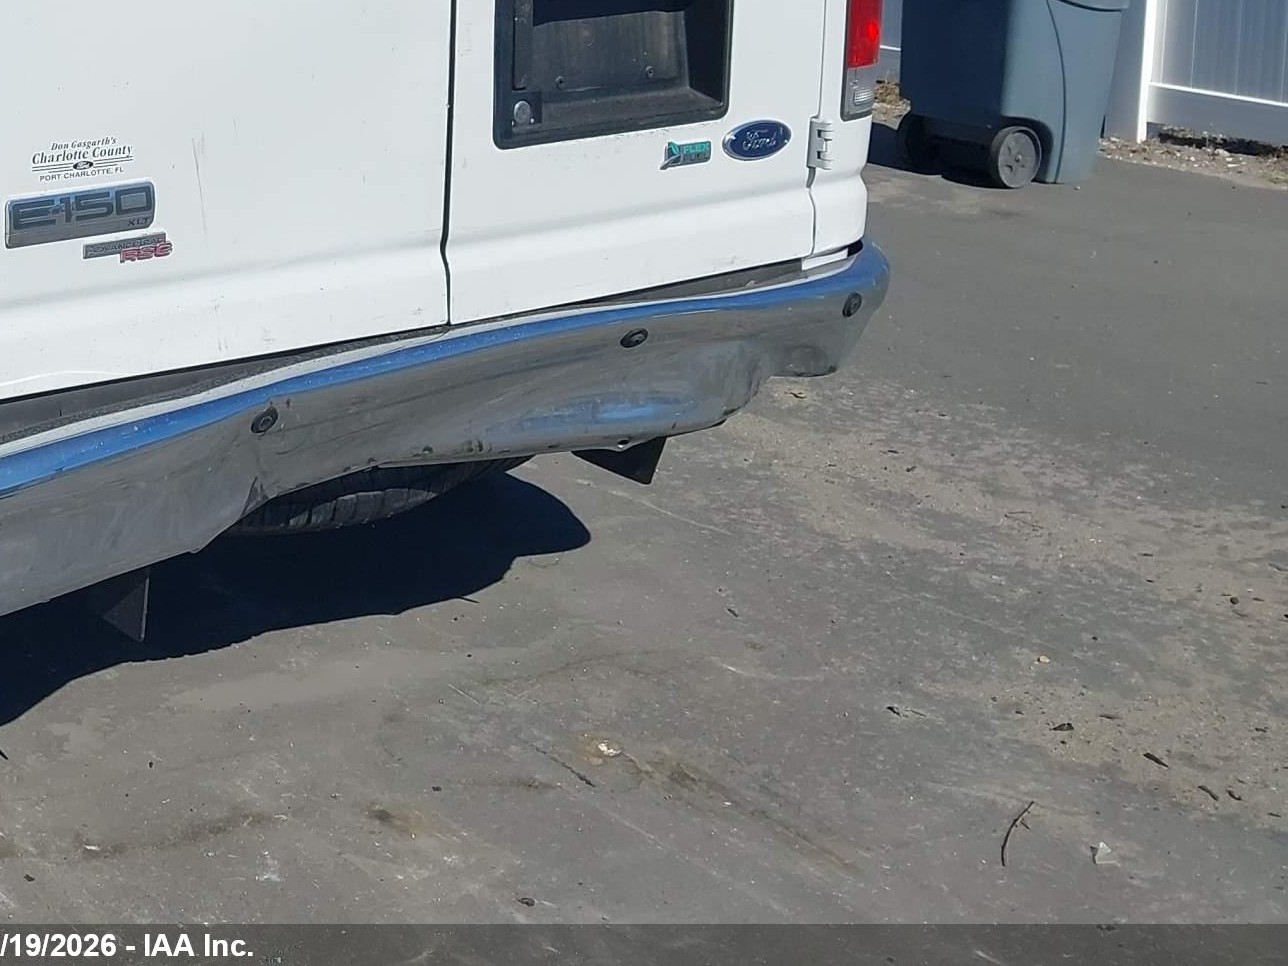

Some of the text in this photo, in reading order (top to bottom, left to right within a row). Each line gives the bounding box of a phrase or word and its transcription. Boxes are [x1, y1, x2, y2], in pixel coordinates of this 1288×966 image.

[50, 137, 117, 151] Don Gasgarth's
[31, 150, 89, 165] Charlotte
[92, 146, 133, 158] County
[39, 174, 61, 182] PORT
[115, 166, 124, 174] FL
[127, 217, 150, 227] XLT
[120, 242, 173, 263] RSC
